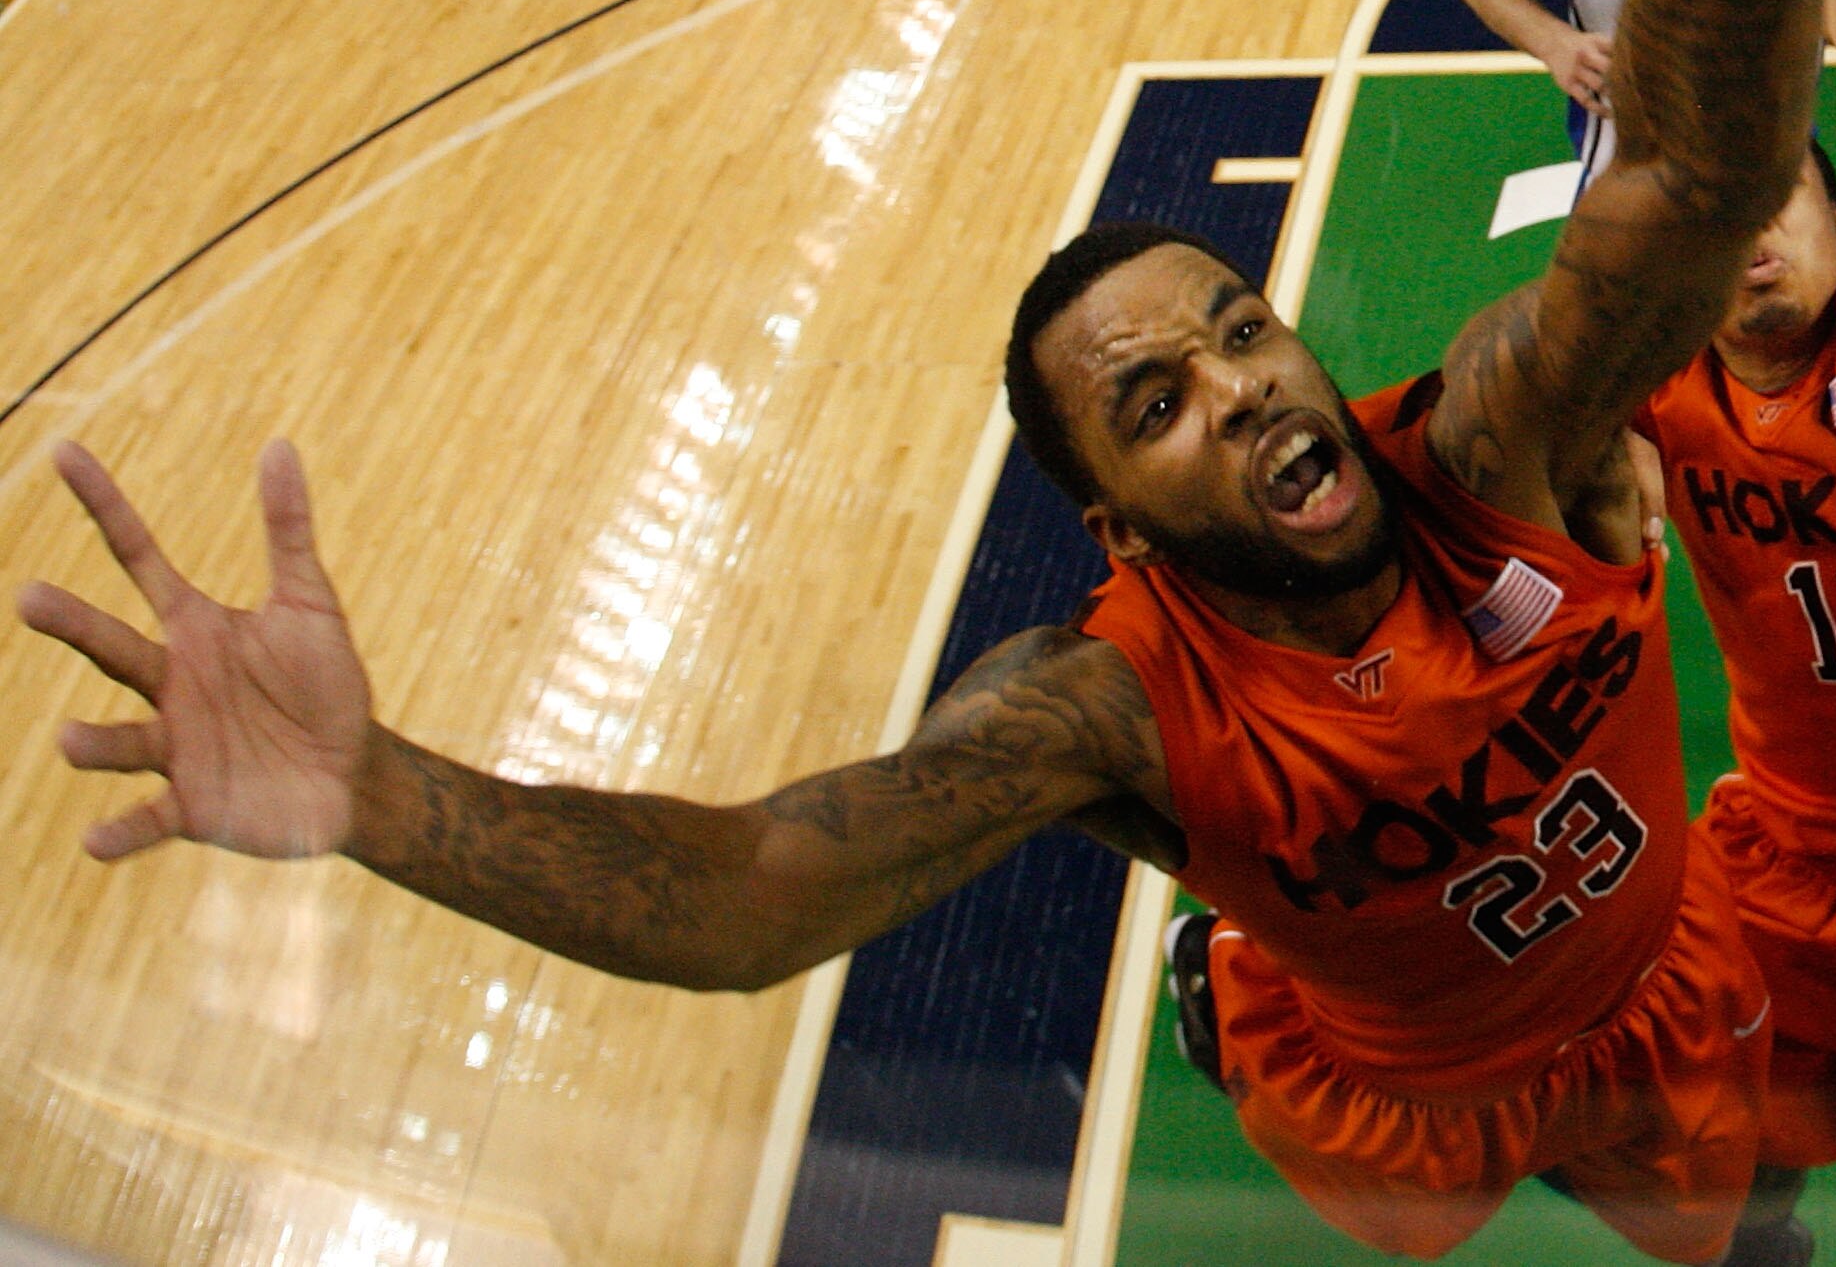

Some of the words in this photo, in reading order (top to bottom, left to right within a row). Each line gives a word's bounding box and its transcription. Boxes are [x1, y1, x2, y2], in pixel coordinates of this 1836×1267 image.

[1266, 614, 1643, 912] HOKIES
[1334, 647, 1396, 702] VT
[1443, 767, 1649, 965] 23
